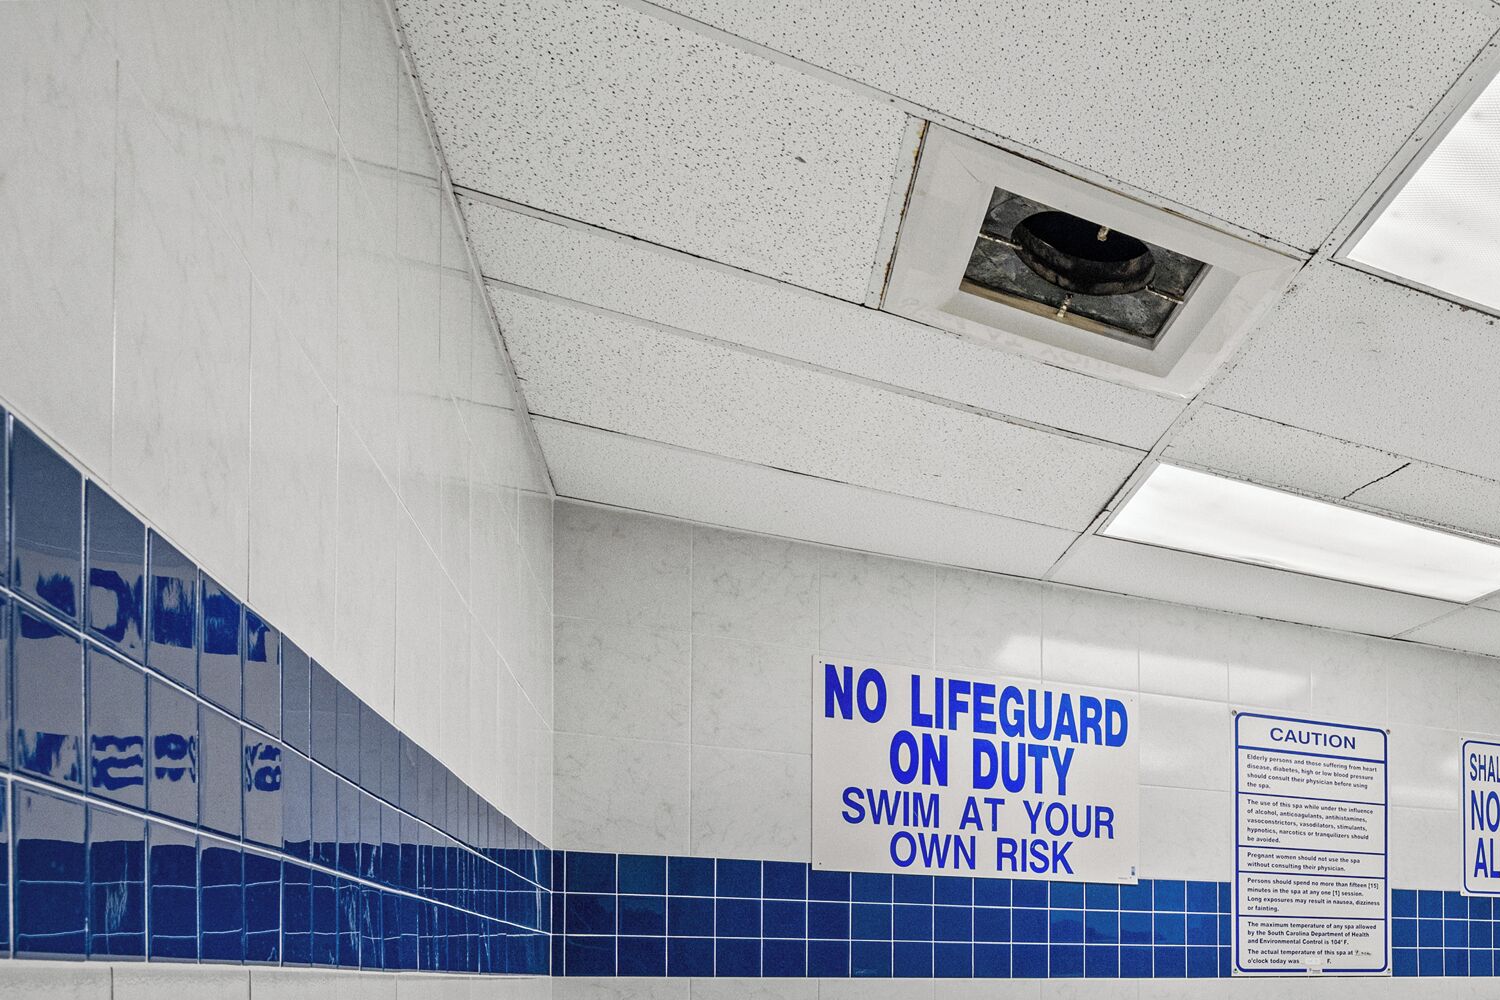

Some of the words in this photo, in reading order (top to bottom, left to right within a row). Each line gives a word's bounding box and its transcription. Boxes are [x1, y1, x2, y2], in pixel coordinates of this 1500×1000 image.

[825, 664, 886, 723] NO
[910, 674, 1128, 747] LIFEGUARD
[1270, 728, 1356, 749] CAUTION
[890, 730, 948, 786] ON
[973, 739, 1075, 795] DUTY
[1247, 753, 1268, 762] Elderly
[1323, 762, 1348, 770] suffering
[842, 787, 939, 829] SWIM
[959, 796, 1005, 831] AT
[1023, 800, 1115, 839] YOUR
[1471, 790, 1500, 832] NO
[890, 831, 976, 870] OWN
[997, 838, 1074, 875] RISK
[1247, 851, 1275, 860] Pregnant
[1271, 863, 1302, 871] consulting
[1247, 929, 1255, 937] by
[1310, 930, 1344, 938] Department
[1290, 922, 1325, 932] temperature
